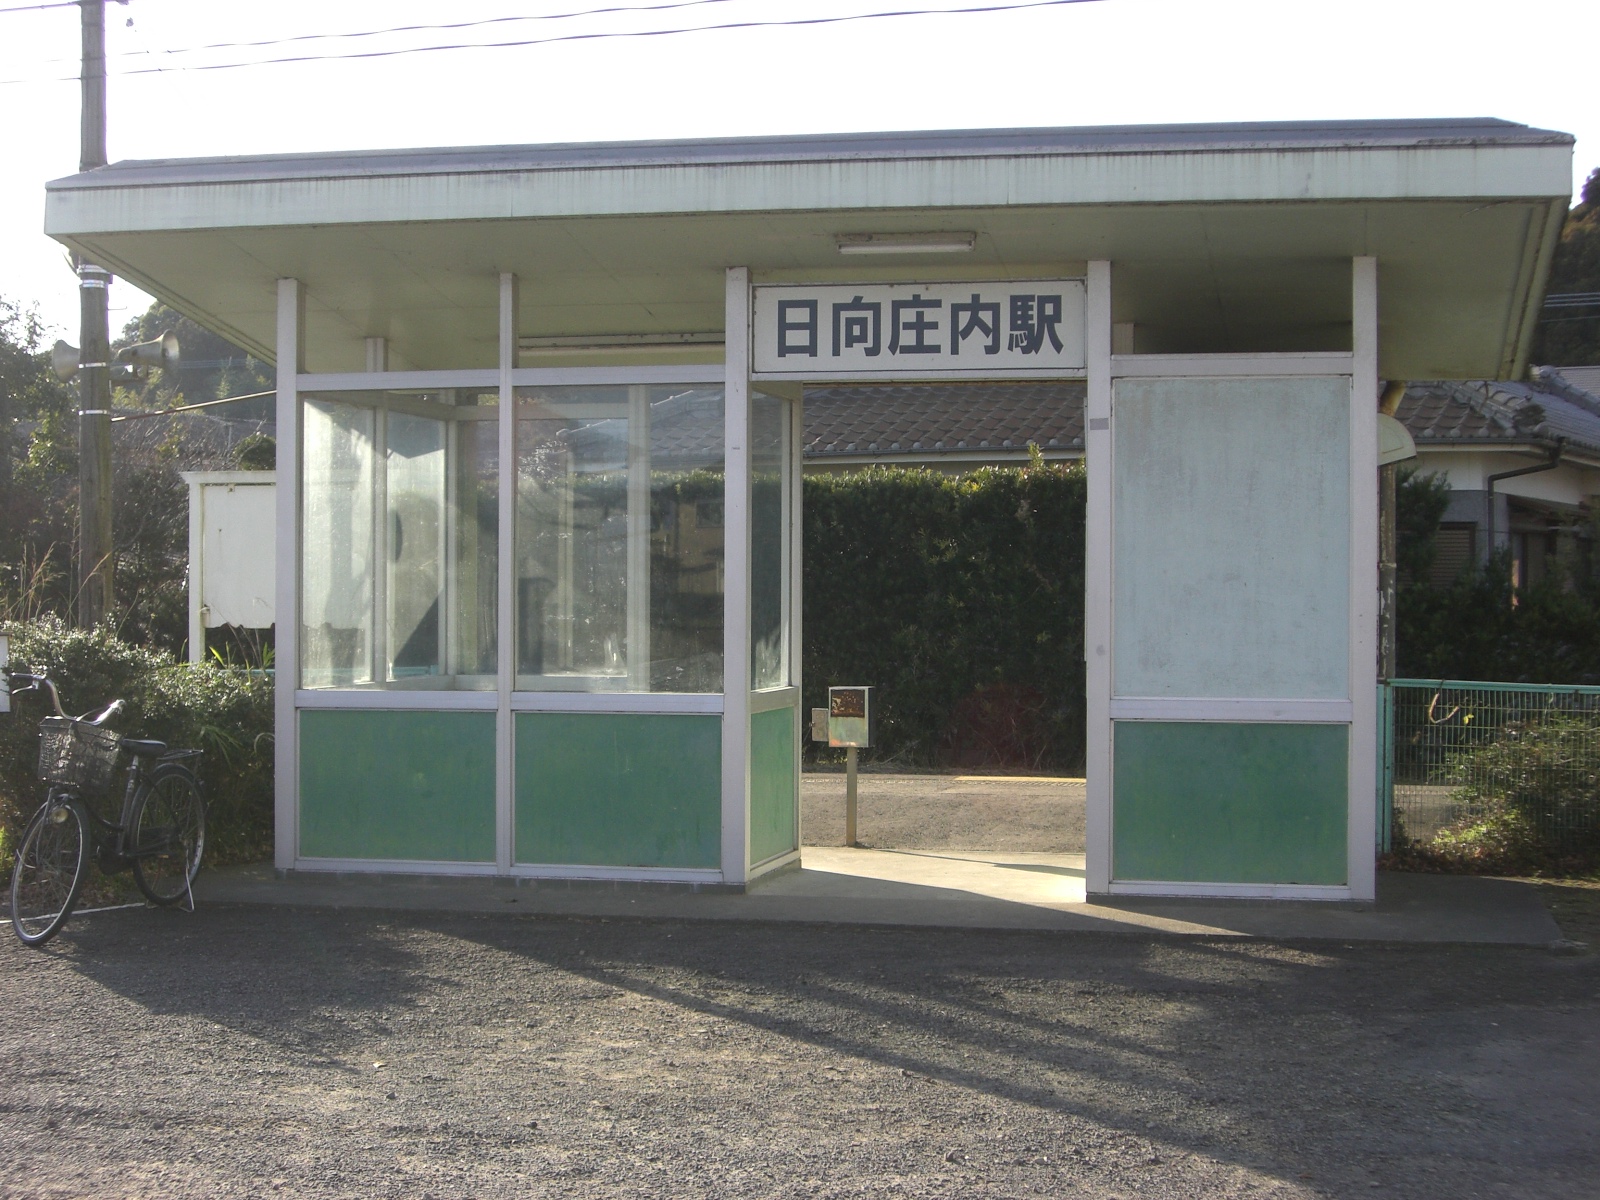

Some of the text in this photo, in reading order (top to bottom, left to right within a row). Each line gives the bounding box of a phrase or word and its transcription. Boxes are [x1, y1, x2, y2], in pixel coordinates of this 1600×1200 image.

[777, 294, 1064, 357] 日向庄内駅
